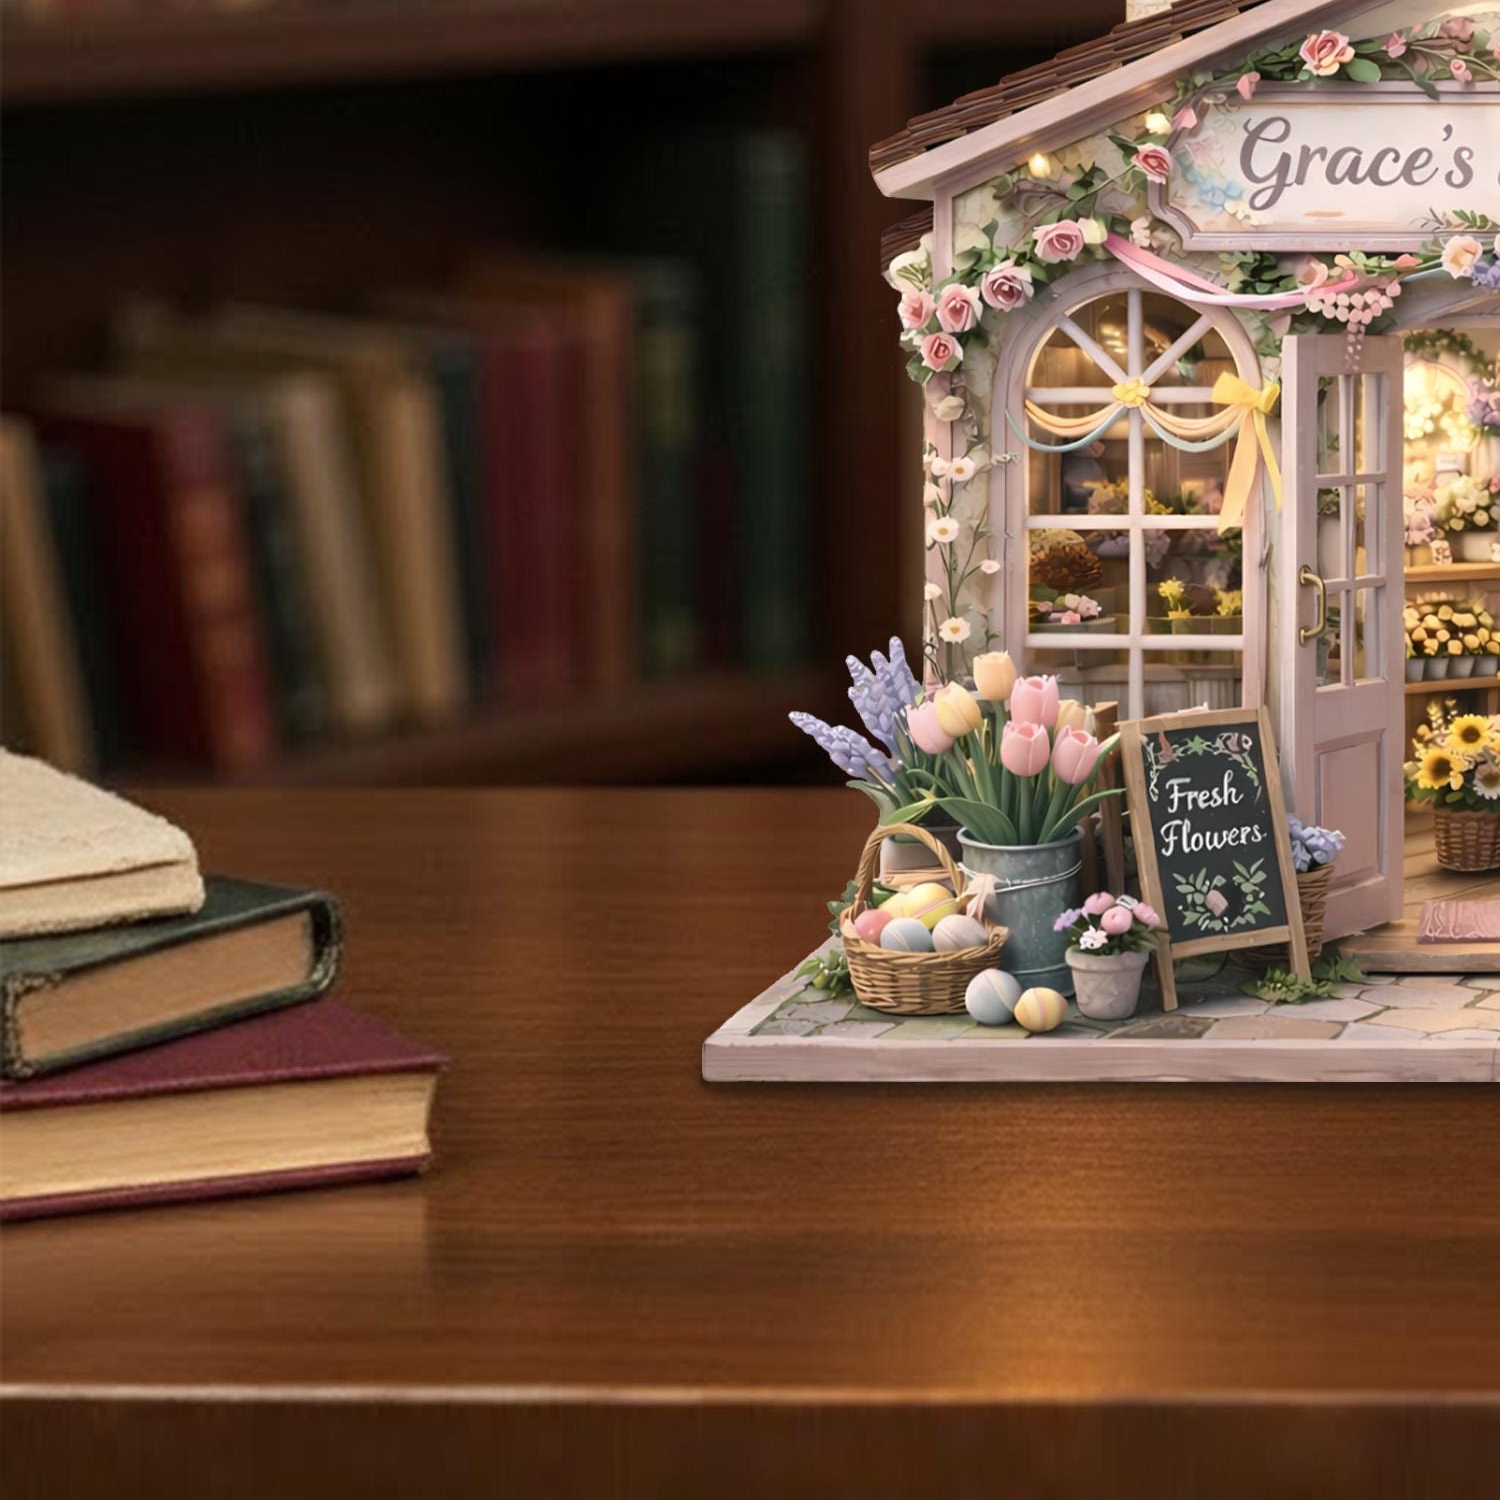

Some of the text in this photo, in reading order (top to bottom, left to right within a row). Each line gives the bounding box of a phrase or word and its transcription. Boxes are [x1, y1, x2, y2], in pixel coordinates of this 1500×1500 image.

[1239, 116, 1475, 211] Grace's
[1165, 769, 1244, 813] Fresh
[1160, 818, 1267, 857] Flowers
